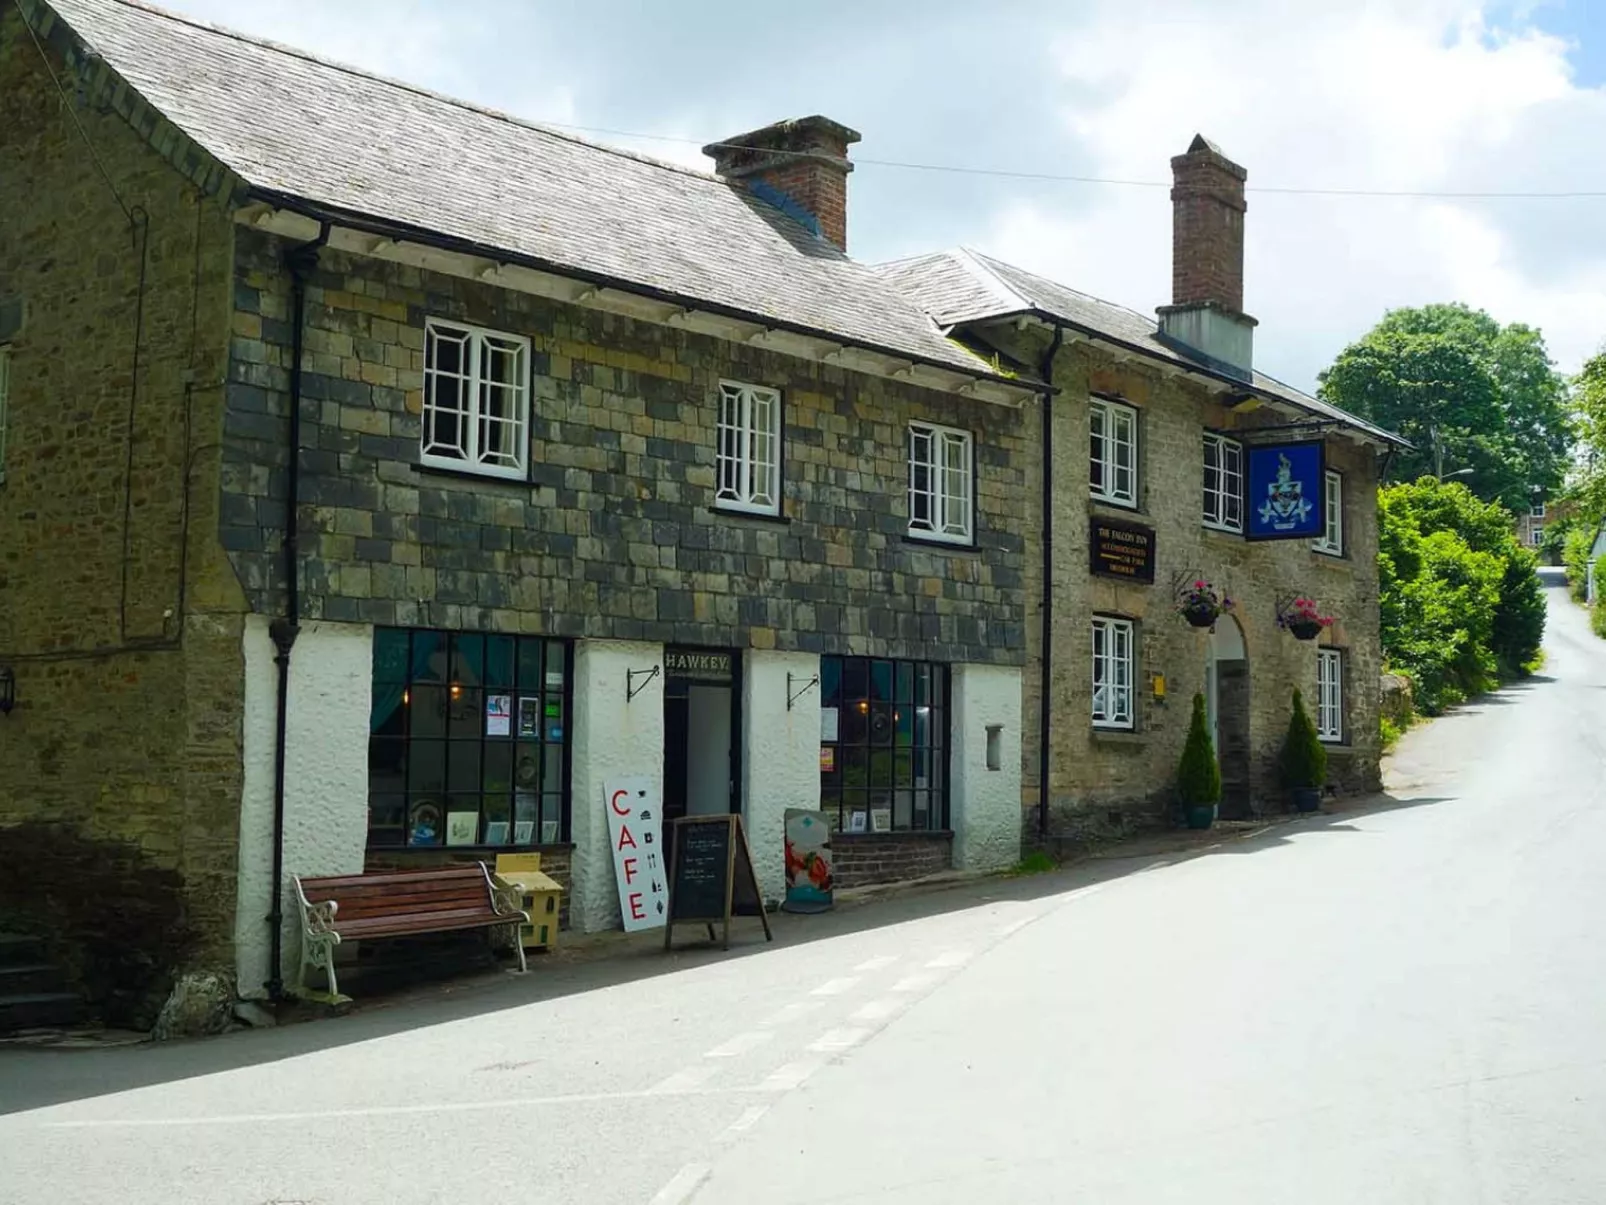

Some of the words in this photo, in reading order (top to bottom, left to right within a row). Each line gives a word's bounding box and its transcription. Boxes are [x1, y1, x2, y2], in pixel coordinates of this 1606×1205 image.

[1111, 530, 1135, 543] FALCON
[1135, 535, 1148, 546] INN
[612, 789, 646, 920] CAFE
